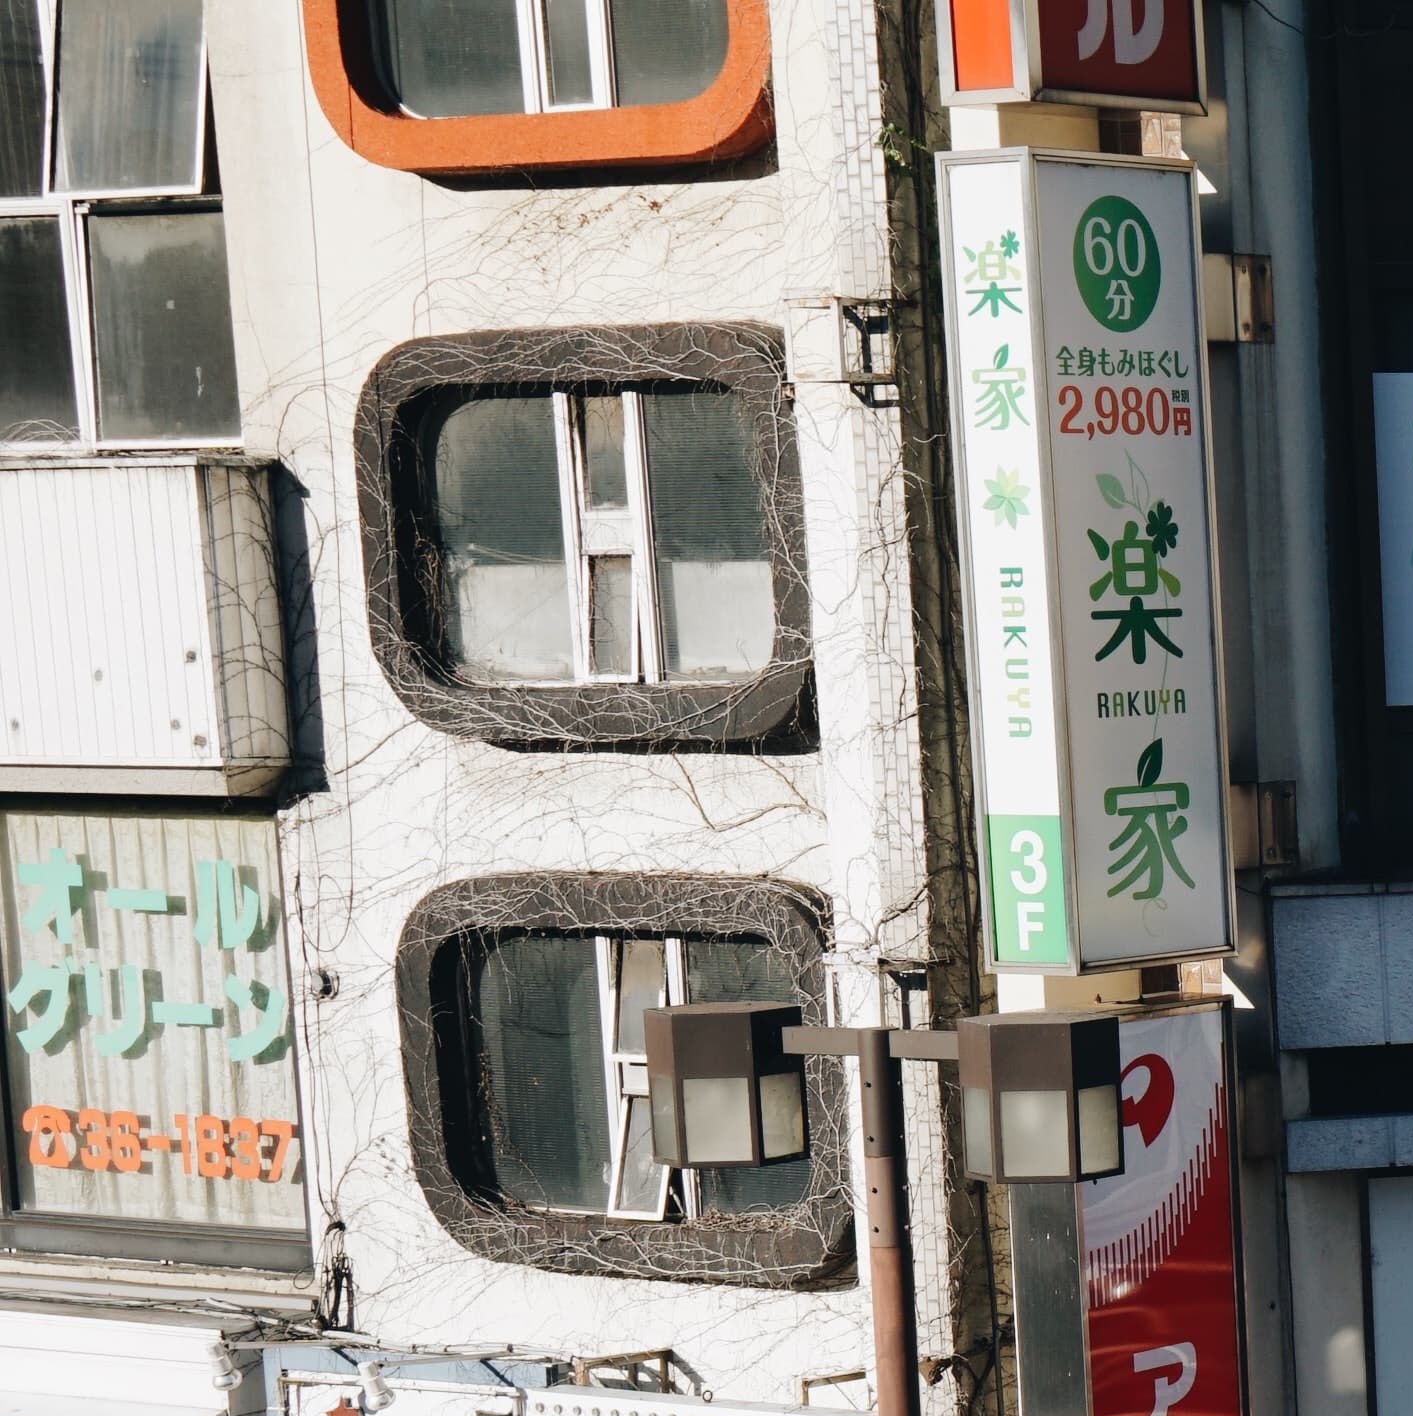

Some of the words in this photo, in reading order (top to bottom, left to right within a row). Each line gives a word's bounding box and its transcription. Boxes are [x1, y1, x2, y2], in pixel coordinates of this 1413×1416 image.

[1083, 216, 1146, 277] 60
[1105, 279, 1135, 320] 分
[1056, 345, 1189, 378] 全身もみほぐし
[1057, 385, 1192, 440] 2,980円
[1000, 566, 1033, 739] RAKUYA
[1097, 690, 1187, 718] RAKUYA
[18, 848, 259, 949] オール
[1008, 829, 1048, 952] 3F
[8, 956, 285, 1061] グリーン
